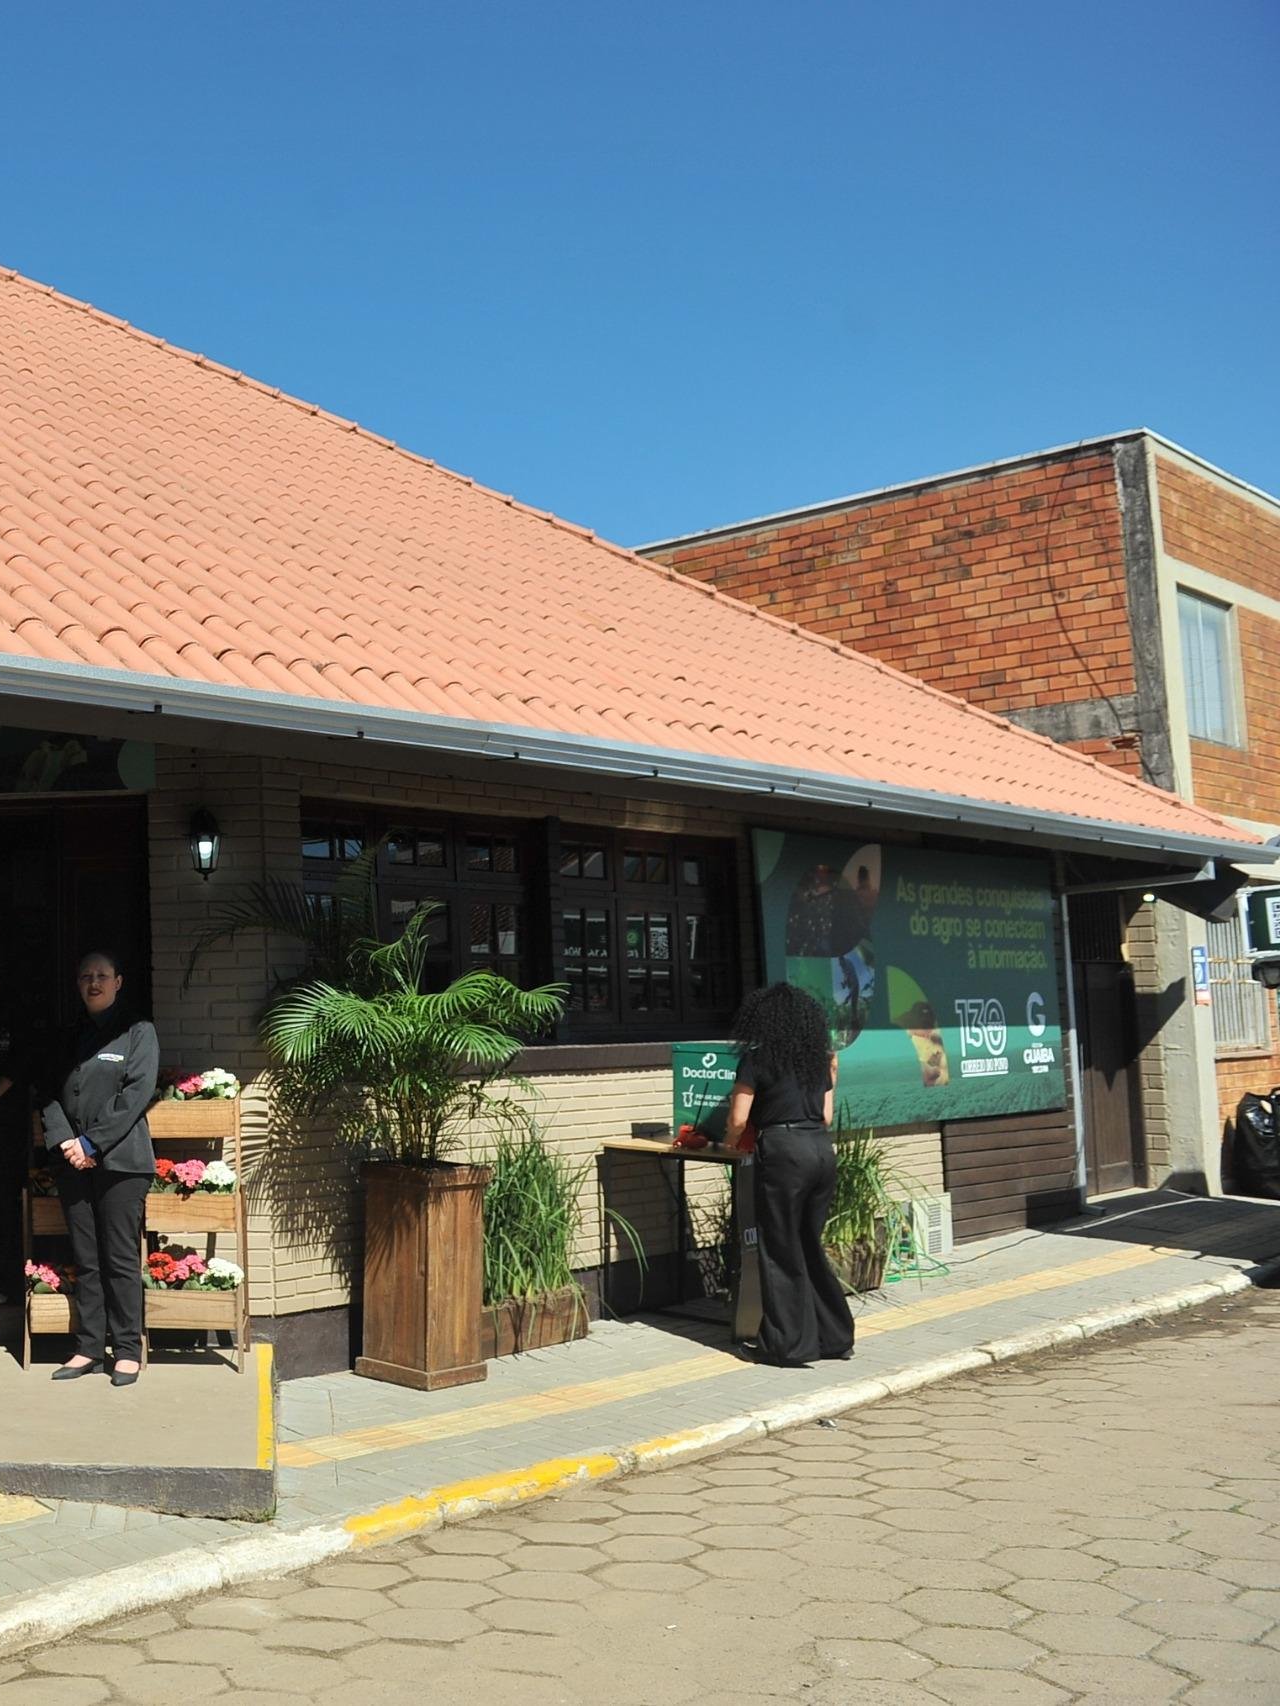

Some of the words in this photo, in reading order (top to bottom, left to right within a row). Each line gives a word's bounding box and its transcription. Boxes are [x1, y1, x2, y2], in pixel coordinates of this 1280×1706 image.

[896, 875, 917, 903] As
[919, 881, 974, 911] grandes
[910, 910, 929, 936] do
[932, 916, 962, 944] agro
[966, 917, 982, 938] se
[682, 1067, 737, 1080] DoctorClin
